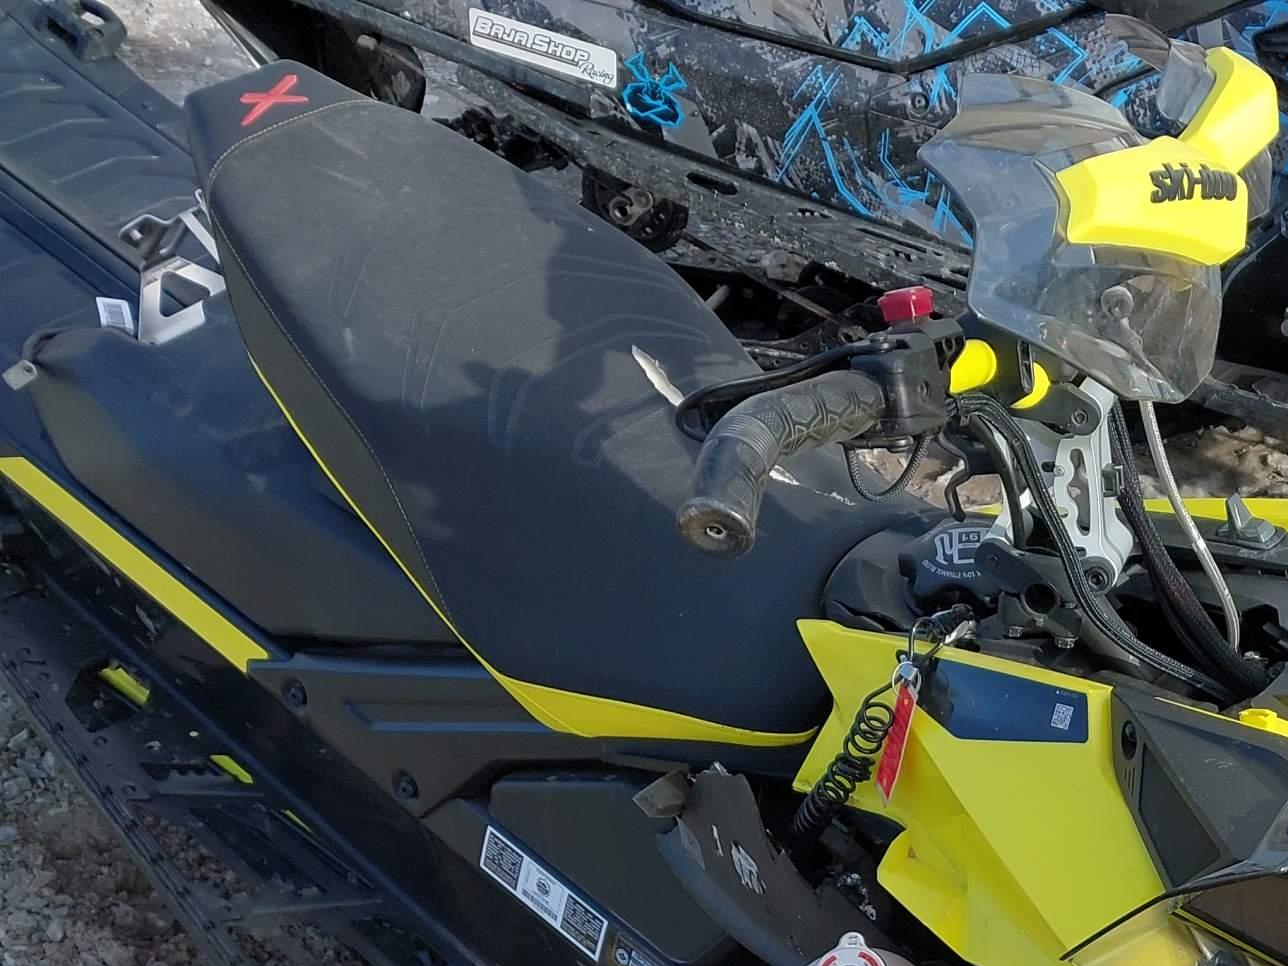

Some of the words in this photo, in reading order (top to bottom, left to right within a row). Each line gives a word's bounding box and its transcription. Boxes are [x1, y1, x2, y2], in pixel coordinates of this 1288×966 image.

[475, 16, 531, 47] BAJA
[531, 33, 590, 63] SHOP
[578, 62, 614, 84] Racing
